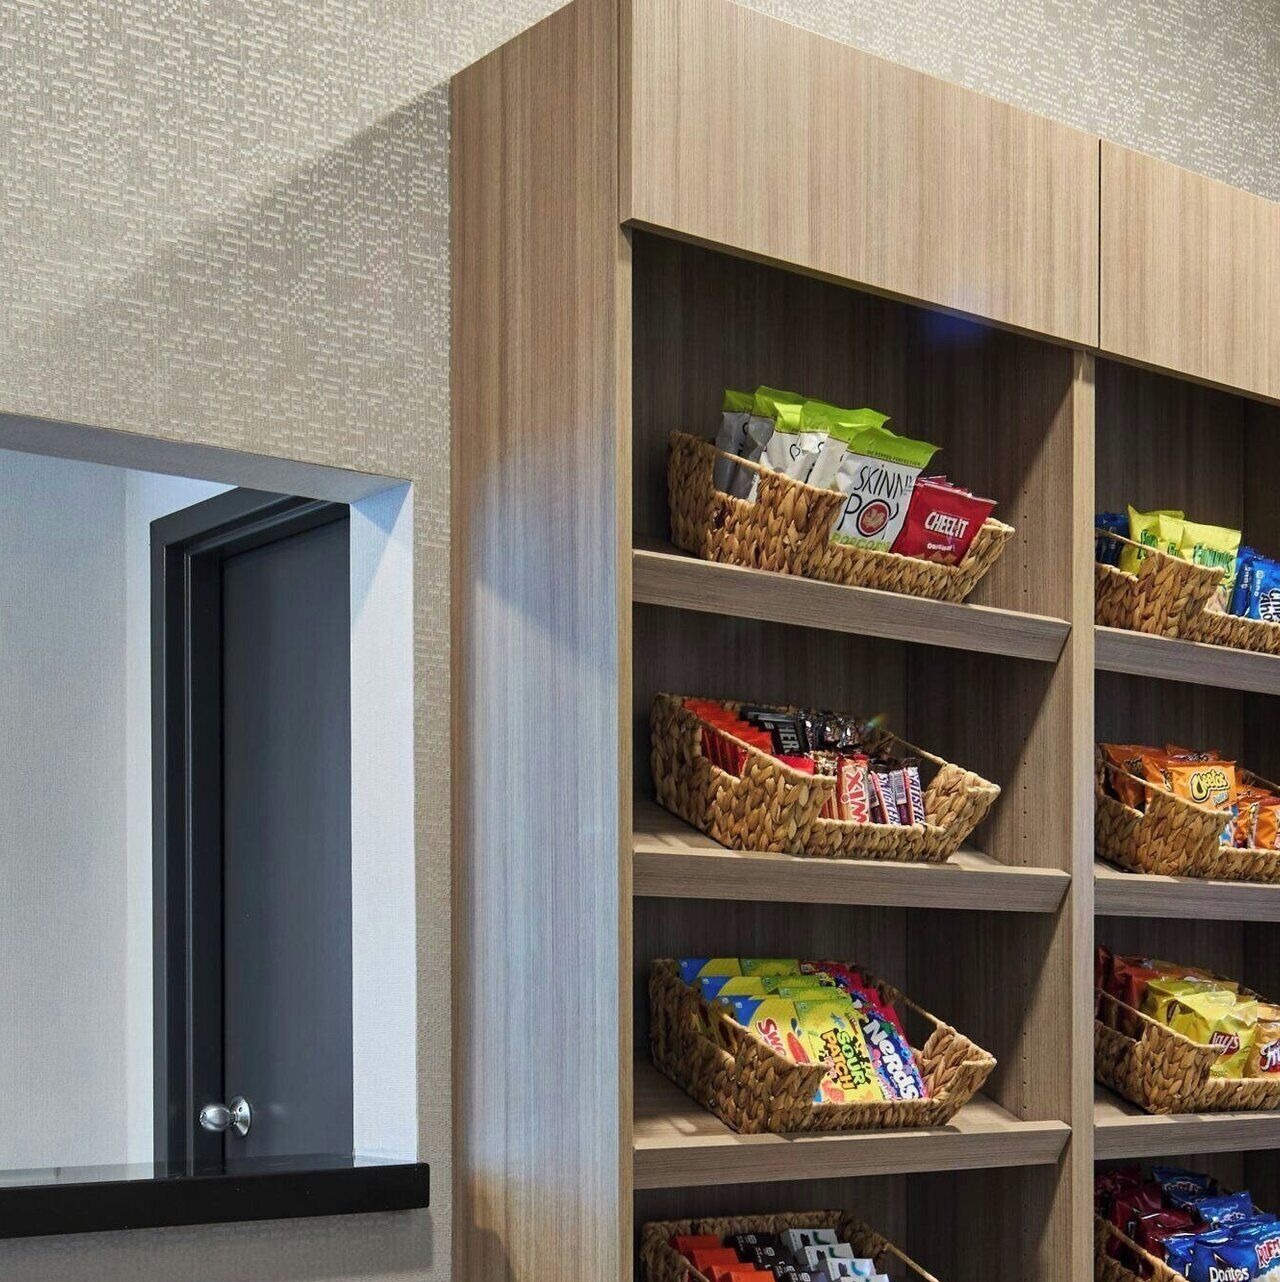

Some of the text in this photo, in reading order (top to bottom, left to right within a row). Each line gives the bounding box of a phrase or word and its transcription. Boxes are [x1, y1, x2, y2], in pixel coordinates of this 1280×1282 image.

[877, 776, 901, 824] SNICKER
[1190, 769, 1231, 803] Cheetos
[821, 1030, 858, 1090] PATCH
[837, 1030, 867, 1085] SOUR
